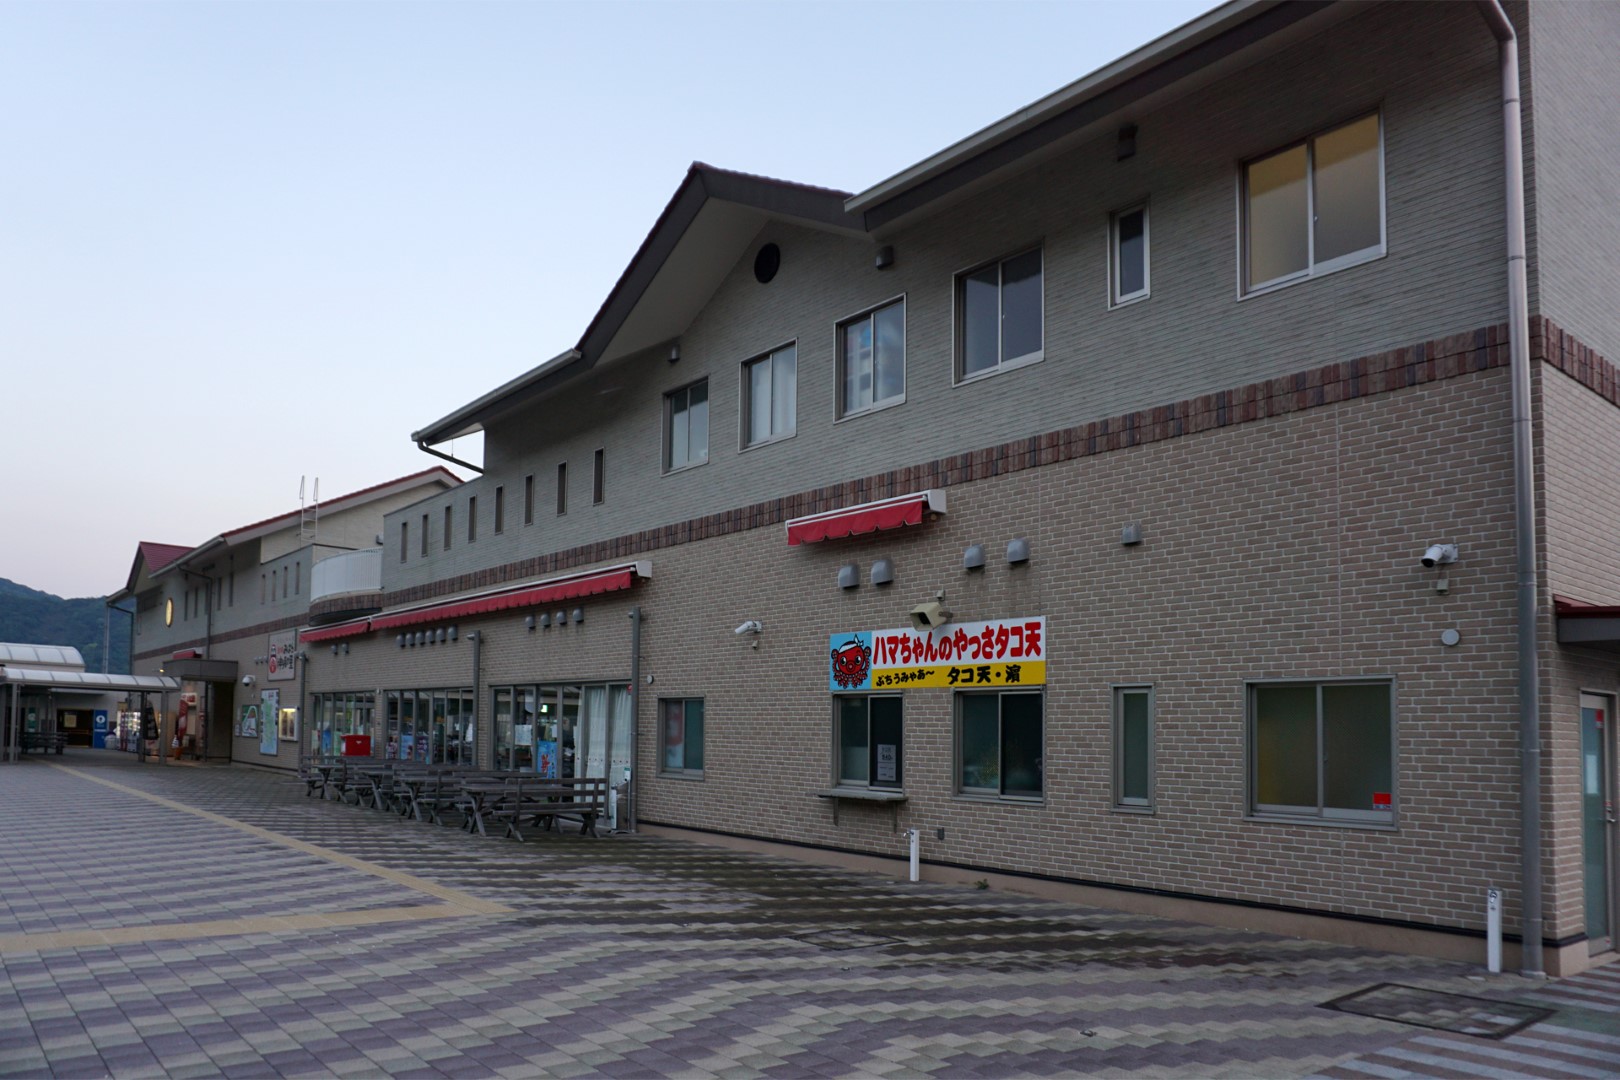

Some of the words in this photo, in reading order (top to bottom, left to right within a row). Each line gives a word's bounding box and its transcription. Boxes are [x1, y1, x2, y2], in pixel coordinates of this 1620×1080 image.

[873, 621, 1042, 665] ハマちゃんのやっさタコ天
